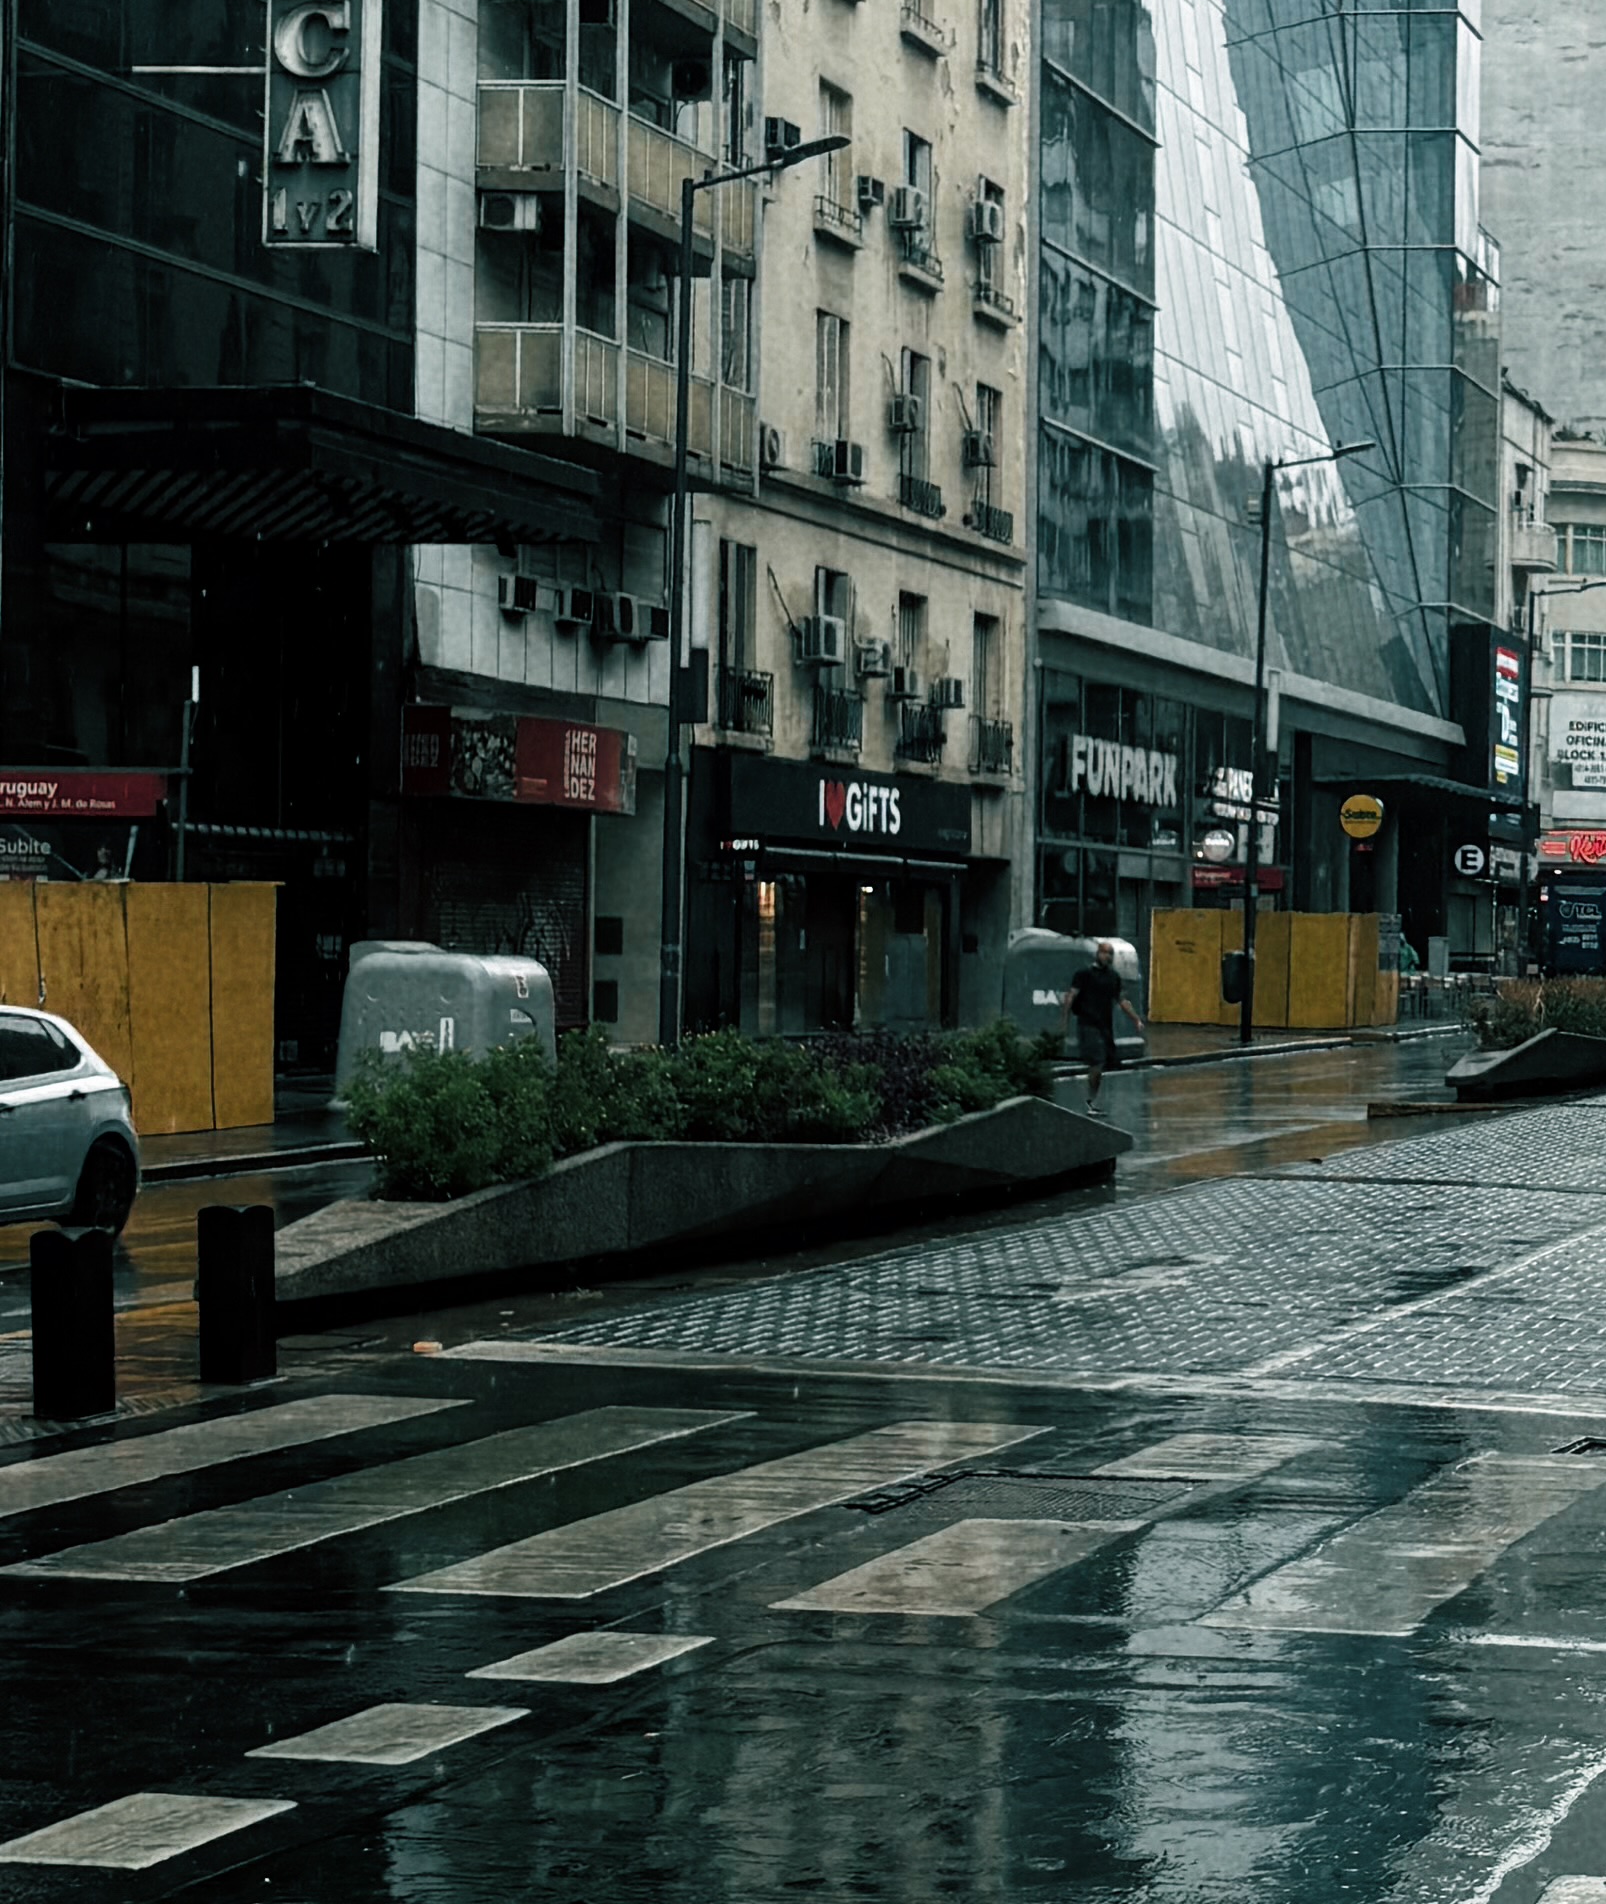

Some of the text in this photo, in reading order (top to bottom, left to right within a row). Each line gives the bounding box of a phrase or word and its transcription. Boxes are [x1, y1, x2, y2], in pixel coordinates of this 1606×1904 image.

[570, 730, 598, 755] HER
[1557, 749, 1595, 761] BLOCK
[570, 753, 597, 778] NAN
[1071, 733, 1178, 809] FUNPARK
[569, 777, 596, 801] DEZ
